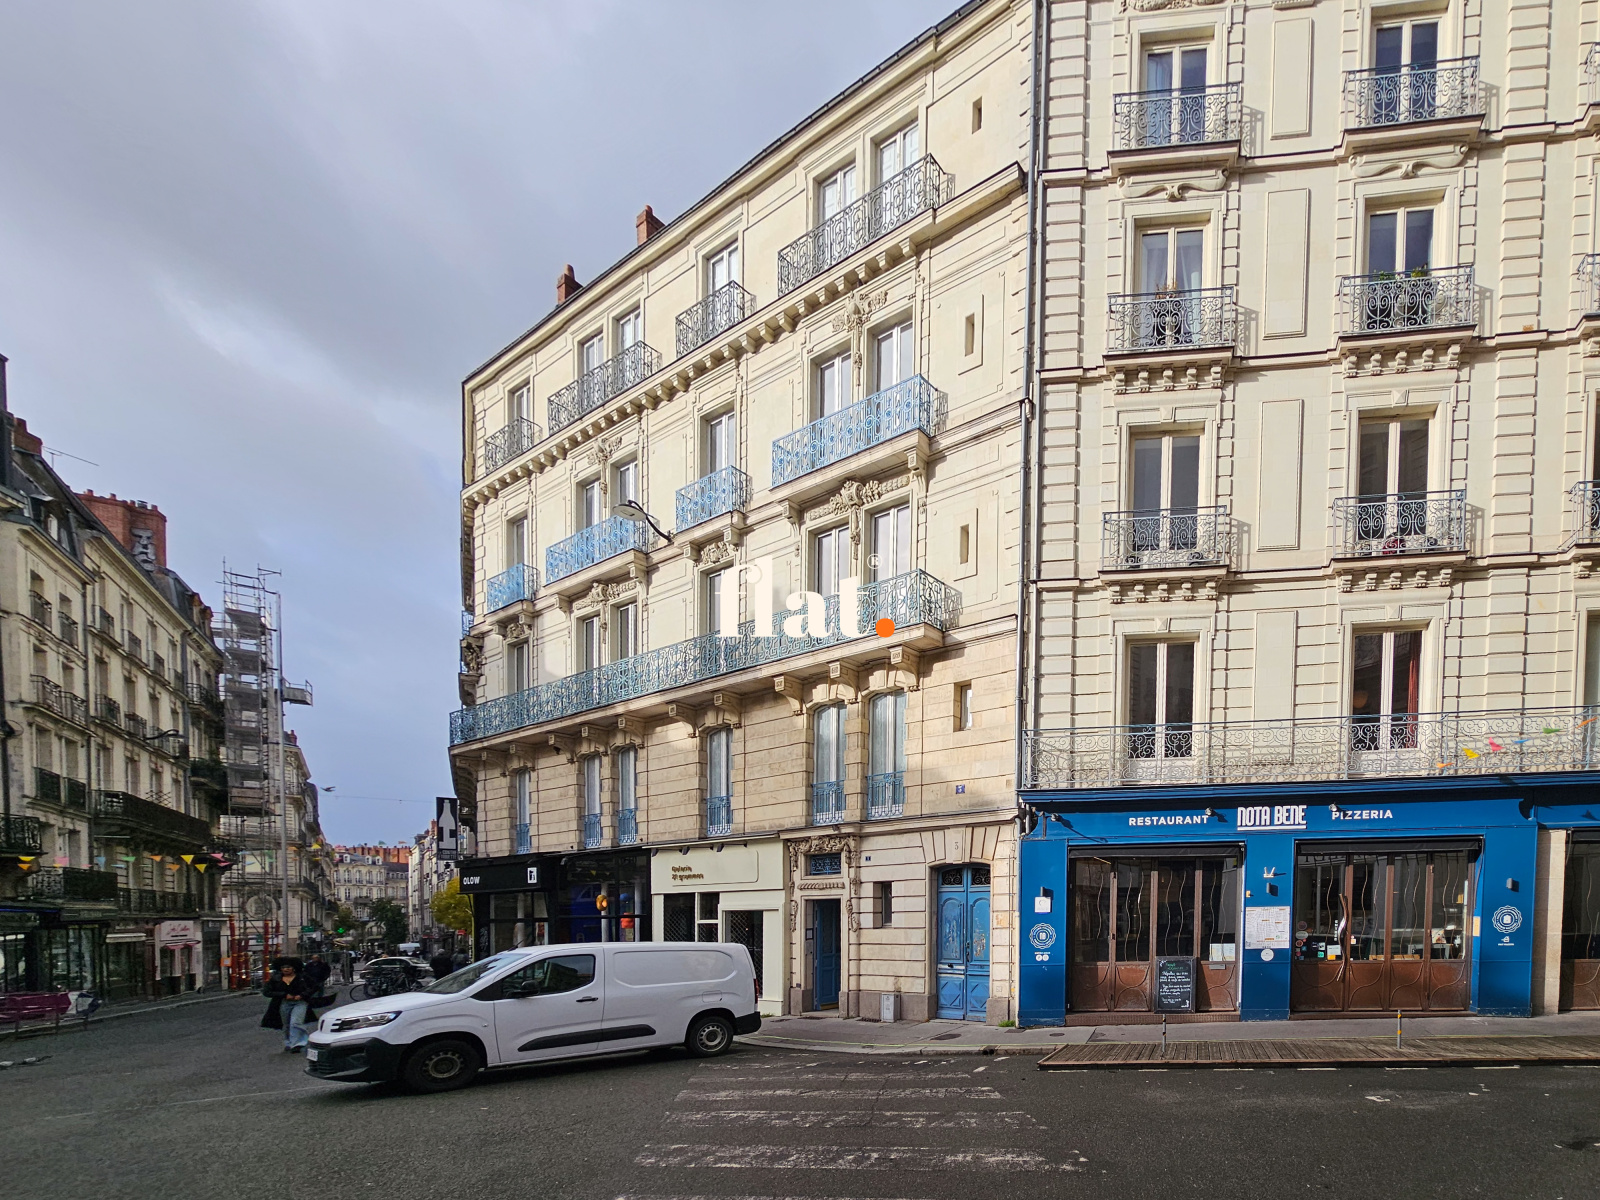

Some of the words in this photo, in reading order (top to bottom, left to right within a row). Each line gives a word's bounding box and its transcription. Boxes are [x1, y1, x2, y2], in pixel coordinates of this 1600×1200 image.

[1237, 805, 1271, 826] NOTA
[1274, 804, 1307, 825] BENE
[1331, 809, 1393, 820] PIZZERIA
[1128, 815, 1209, 826] RESTAURANT
[463, 876, 480, 885] OLOW
